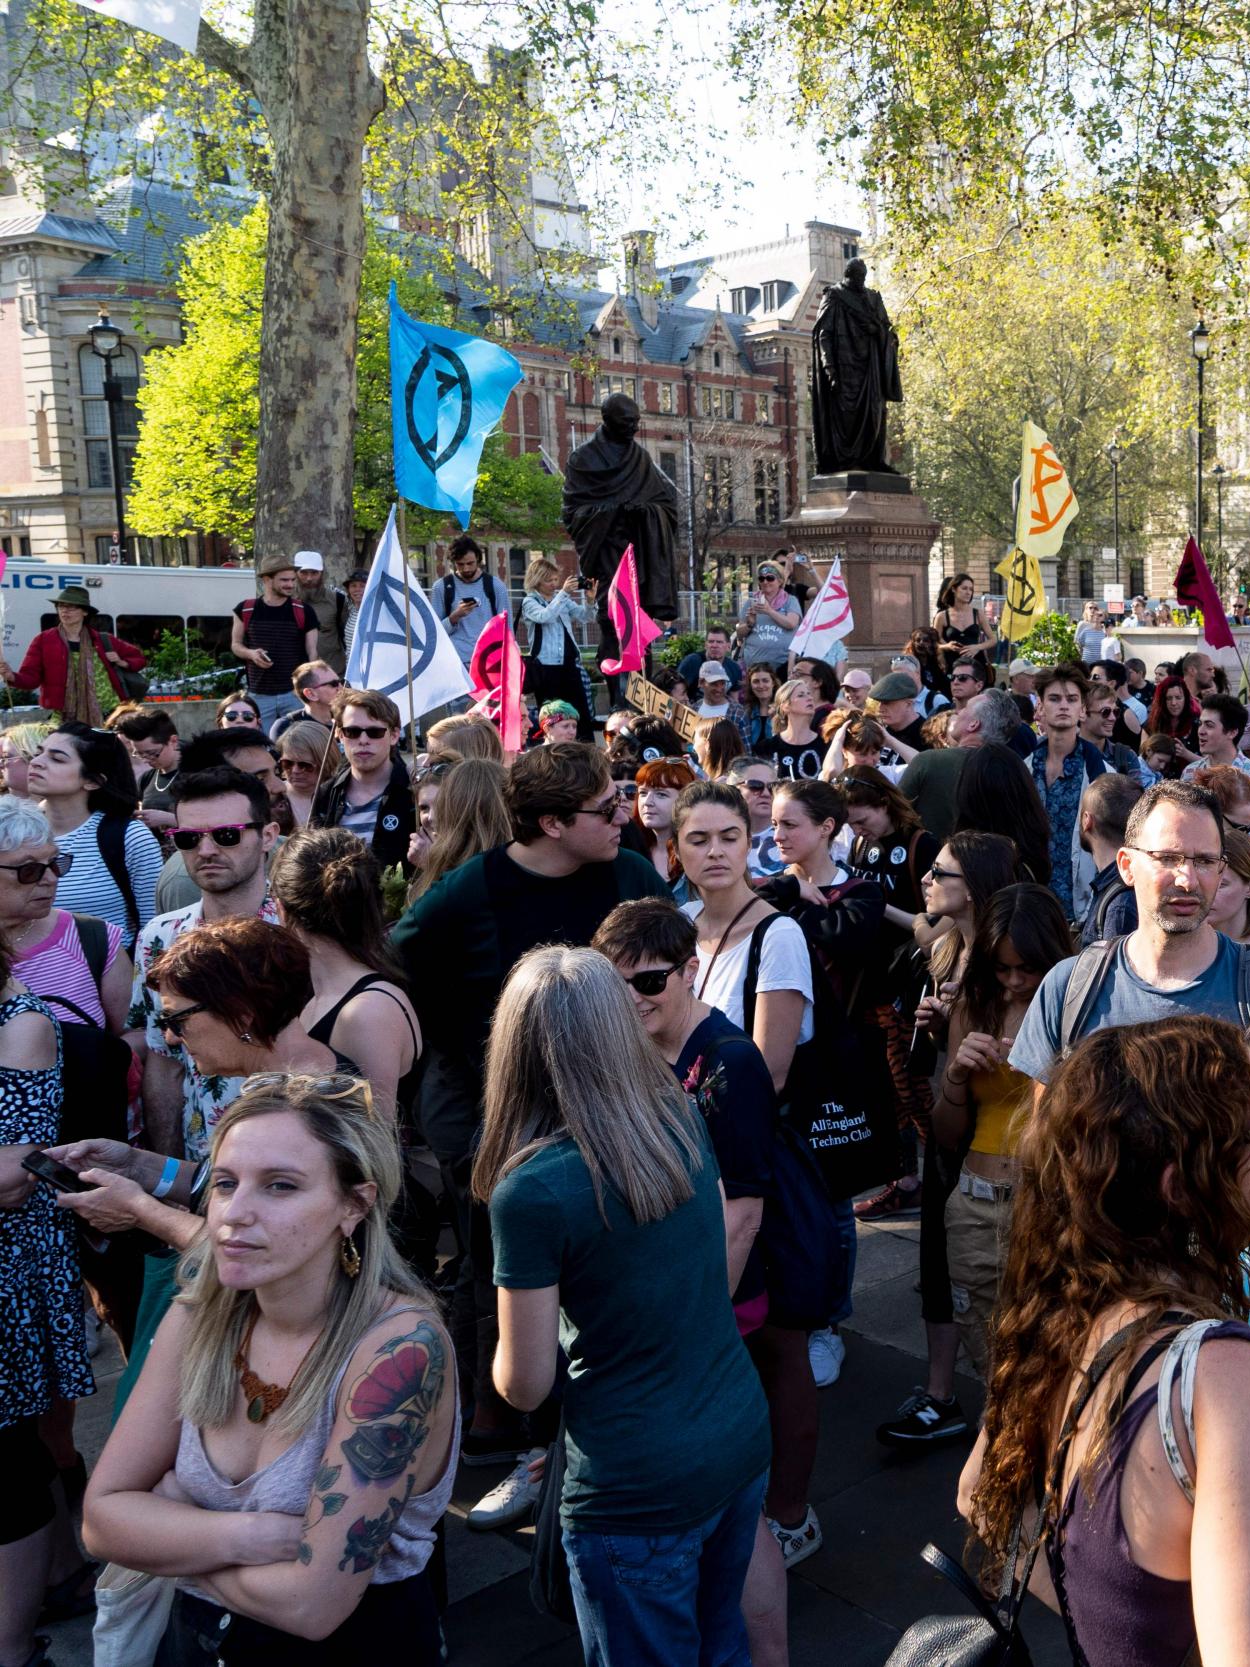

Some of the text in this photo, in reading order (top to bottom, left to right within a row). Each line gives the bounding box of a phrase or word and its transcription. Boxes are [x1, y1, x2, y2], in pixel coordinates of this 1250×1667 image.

[672, 701, 698, 741] HE
[822, 1101, 844, 1114] The
[811, 1111, 866, 1132] All England
[809, 1126, 871, 1149] Techno Club
